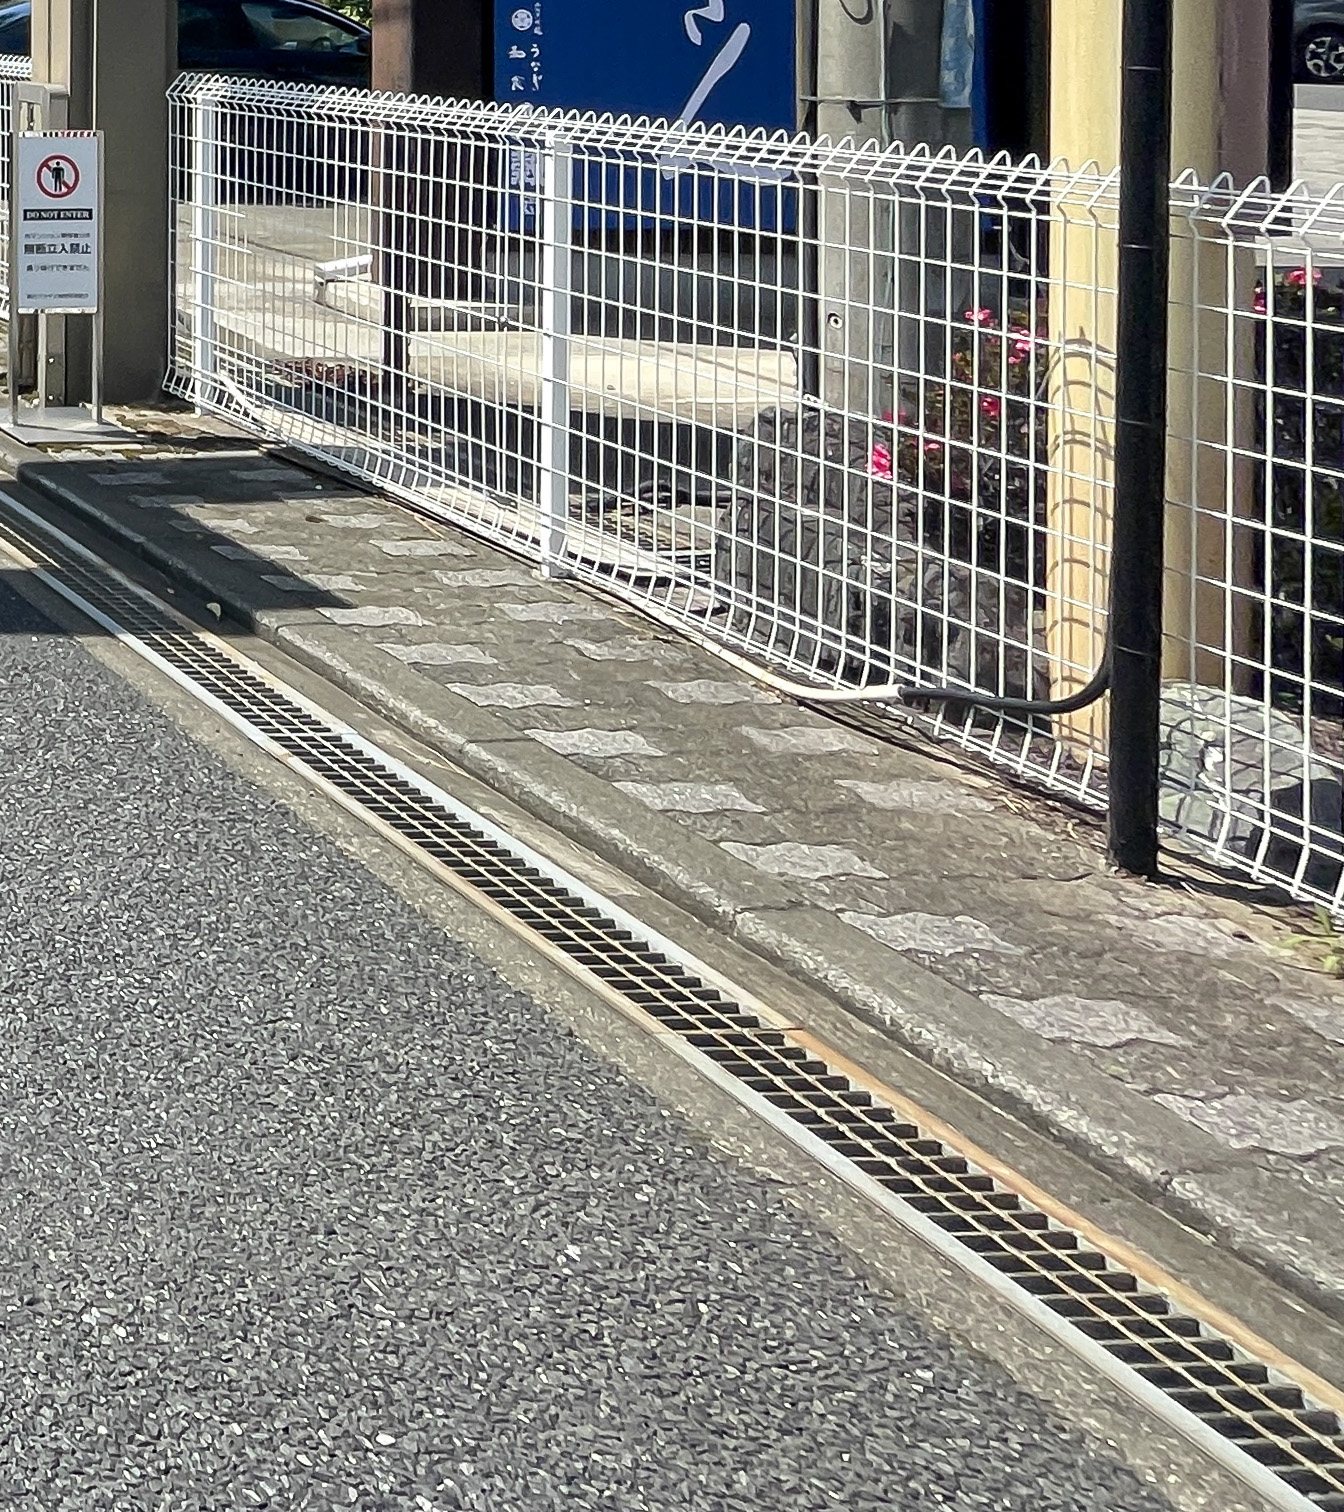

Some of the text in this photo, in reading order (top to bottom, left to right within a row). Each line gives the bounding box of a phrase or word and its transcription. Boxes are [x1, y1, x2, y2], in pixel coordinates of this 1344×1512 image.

[26, 210, 90, 220] DO NOT ENTER
[24, 243, 92, 255] 無断立入禁止
